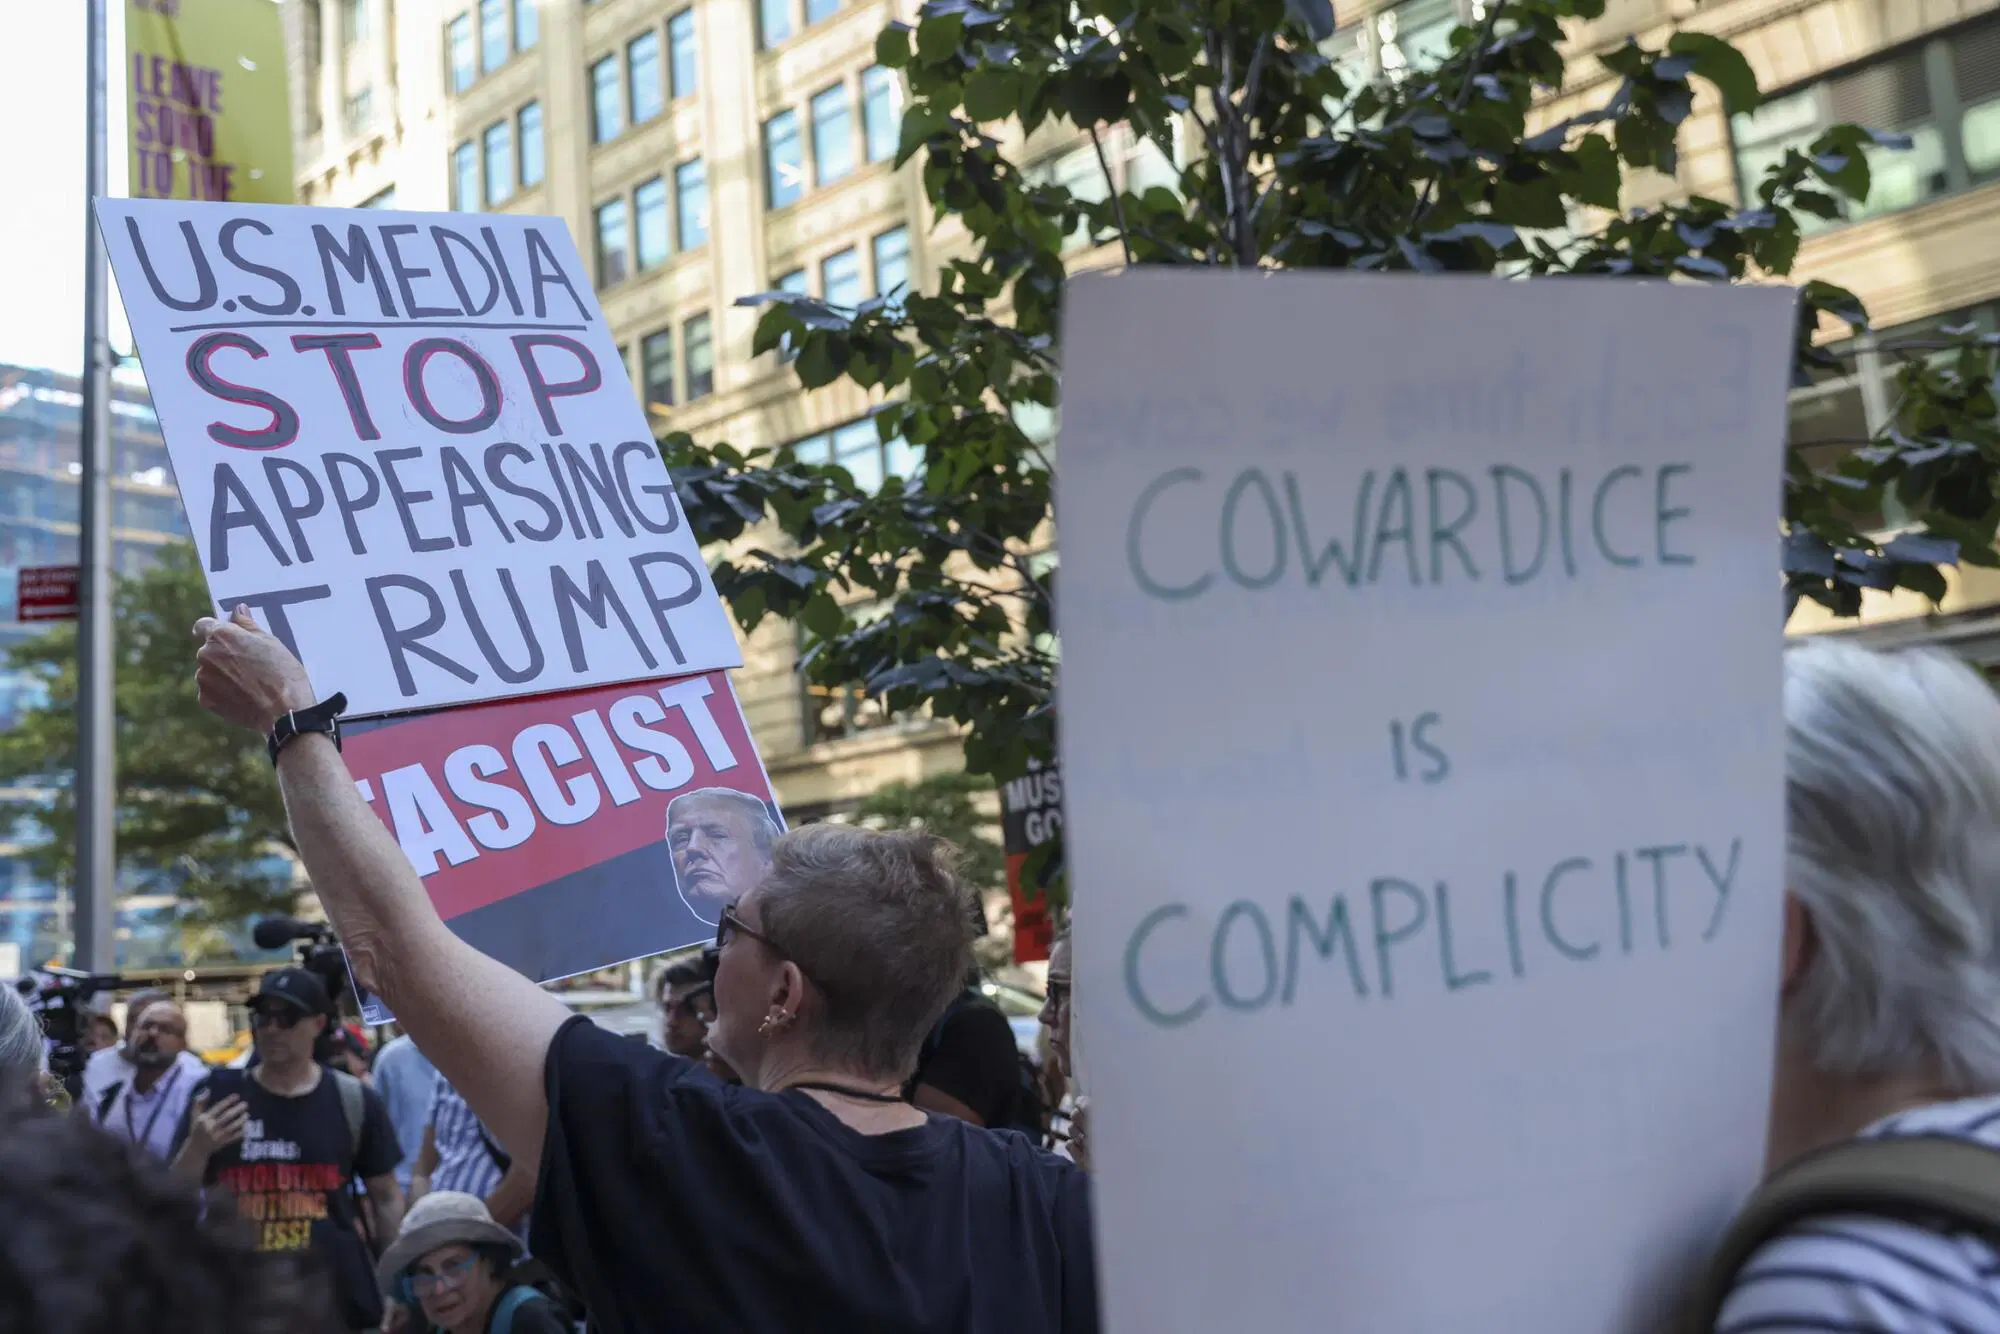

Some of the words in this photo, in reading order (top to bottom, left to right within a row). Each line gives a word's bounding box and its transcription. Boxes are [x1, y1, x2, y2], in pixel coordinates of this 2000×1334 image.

[185, 332, 602, 450] STOP
[209, 442, 678, 573] APPEASING
[1125, 462, 1698, 602] COWARDICE
[354, 675, 738, 878] ASCIST
[1391, 711, 1451, 783] IS
[1123, 836, 1742, 1028] COMPLICITY
